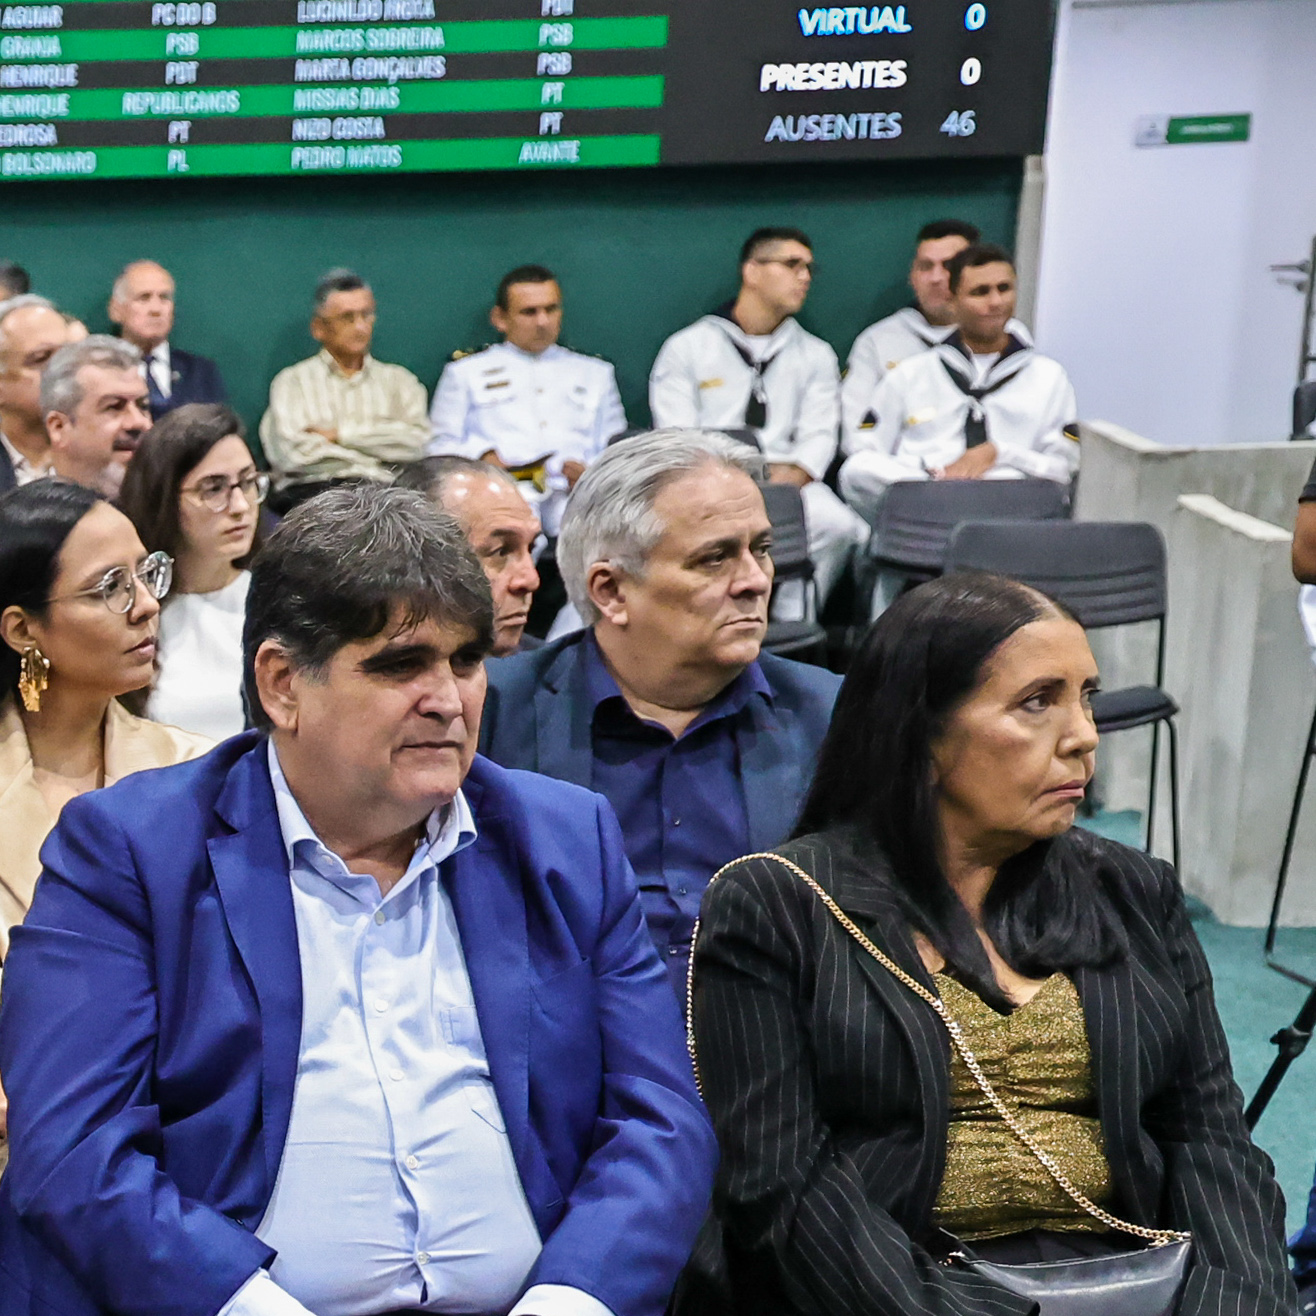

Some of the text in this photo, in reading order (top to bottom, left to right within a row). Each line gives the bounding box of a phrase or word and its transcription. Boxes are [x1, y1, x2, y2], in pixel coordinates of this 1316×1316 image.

[1, 5, 64, 29] AGUIAR
[798, 2, 987, 36] VIRTUAL 0
[296, 28, 365, 52] MARCOS
[539, 23, 574, 47] PSB
[0, 63, 79, 88] HENRIQUE
[351, 55, 446, 85] GONÇALVES
[537, 52, 572, 76] PSB
[760, 57, 982, 92] PRESENTES 0
[122, 90, 240, 115] REPUBLICANOS
[359, 86, 400, 110] DIAS
[541, 82, 565, 105] PT
[168, 120, 191, 144] PT
[332, 116, 386, 140] COSTA
[539, 111, 564, 136] PT
[764, 110, 976, 142] AUSENTES 46
[1, 151, 97, 176] BOLSONARO
[168, 149, 190, 173] PL
[291, 144, 403, 170] PEDRO MATOS
[517, 140, 581, 164] AVANTE
